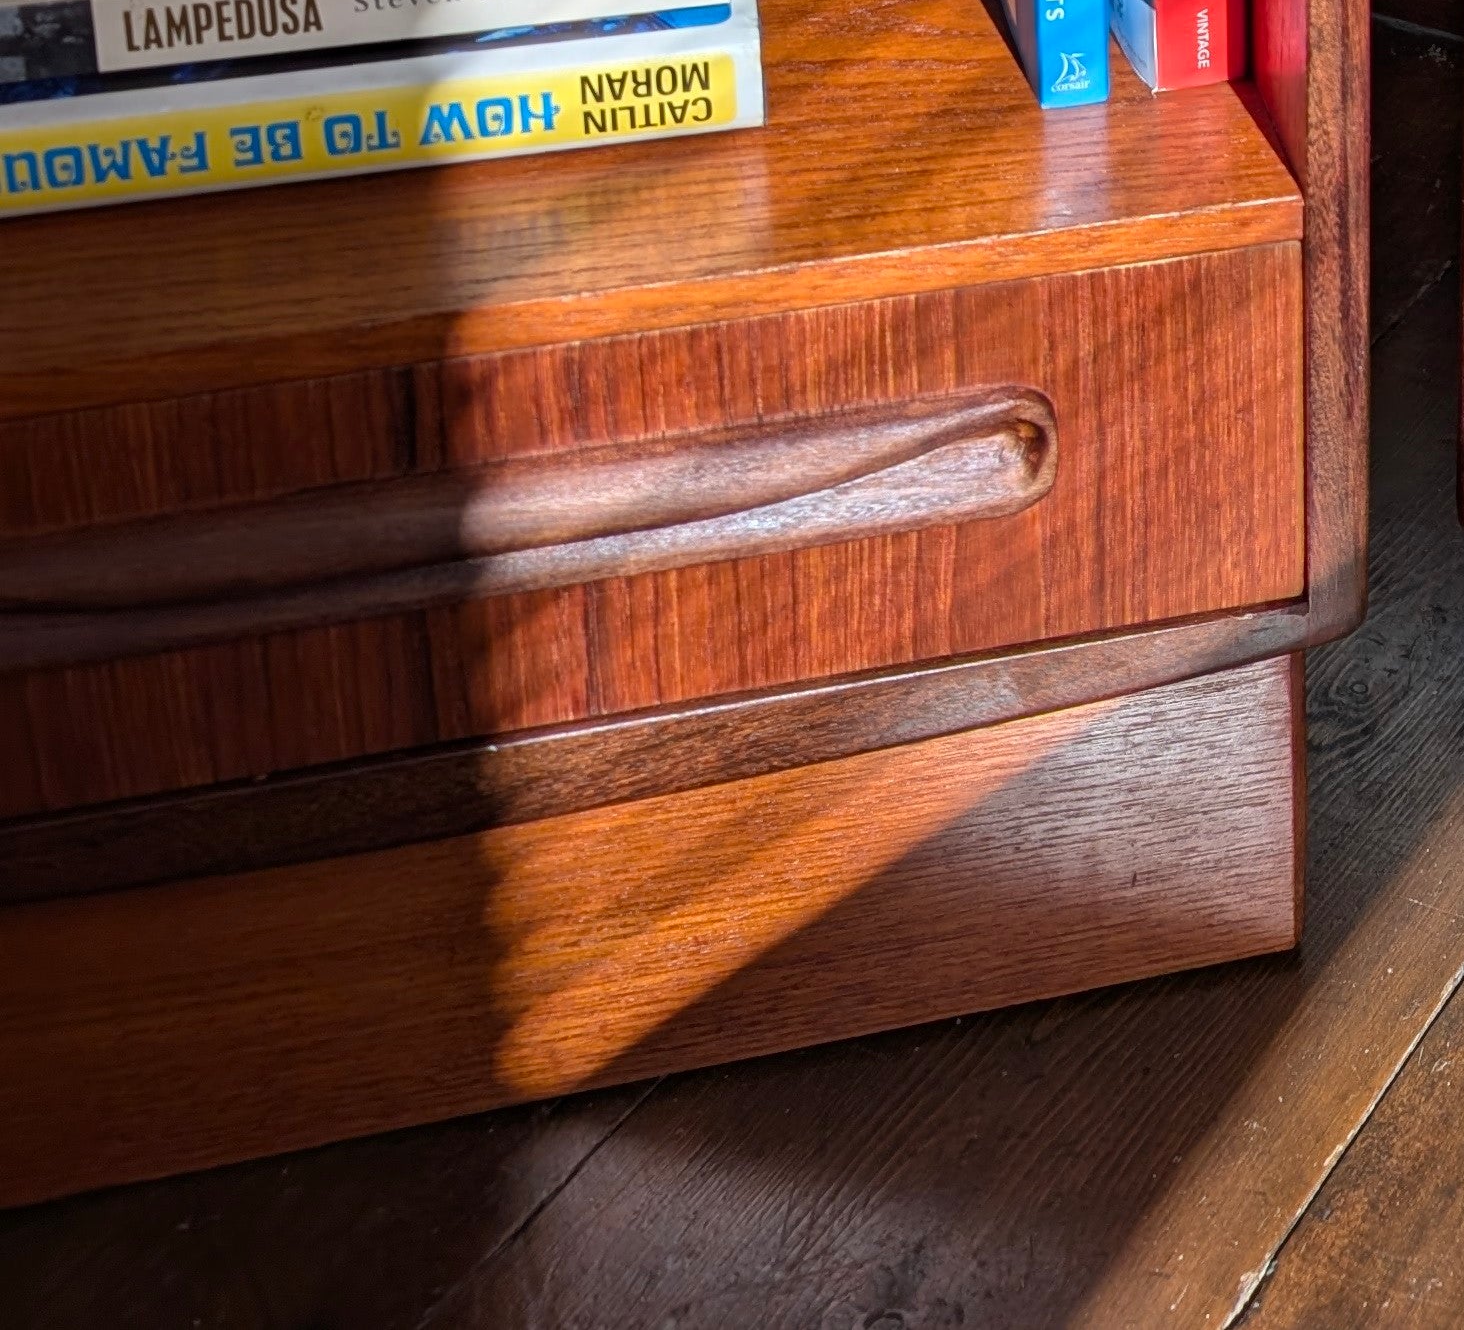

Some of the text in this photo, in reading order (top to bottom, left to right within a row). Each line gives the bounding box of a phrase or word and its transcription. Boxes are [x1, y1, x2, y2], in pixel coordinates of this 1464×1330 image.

[1196, 8, 1211, 70] VINTAGE
[580, 61, 711, 105] MORAN
[1051, 80, 1091, 93] corsair
[583, 96, 713, 135] CAITLIN
[0, 91, 560, 194] HOW TO BE FAMOU
